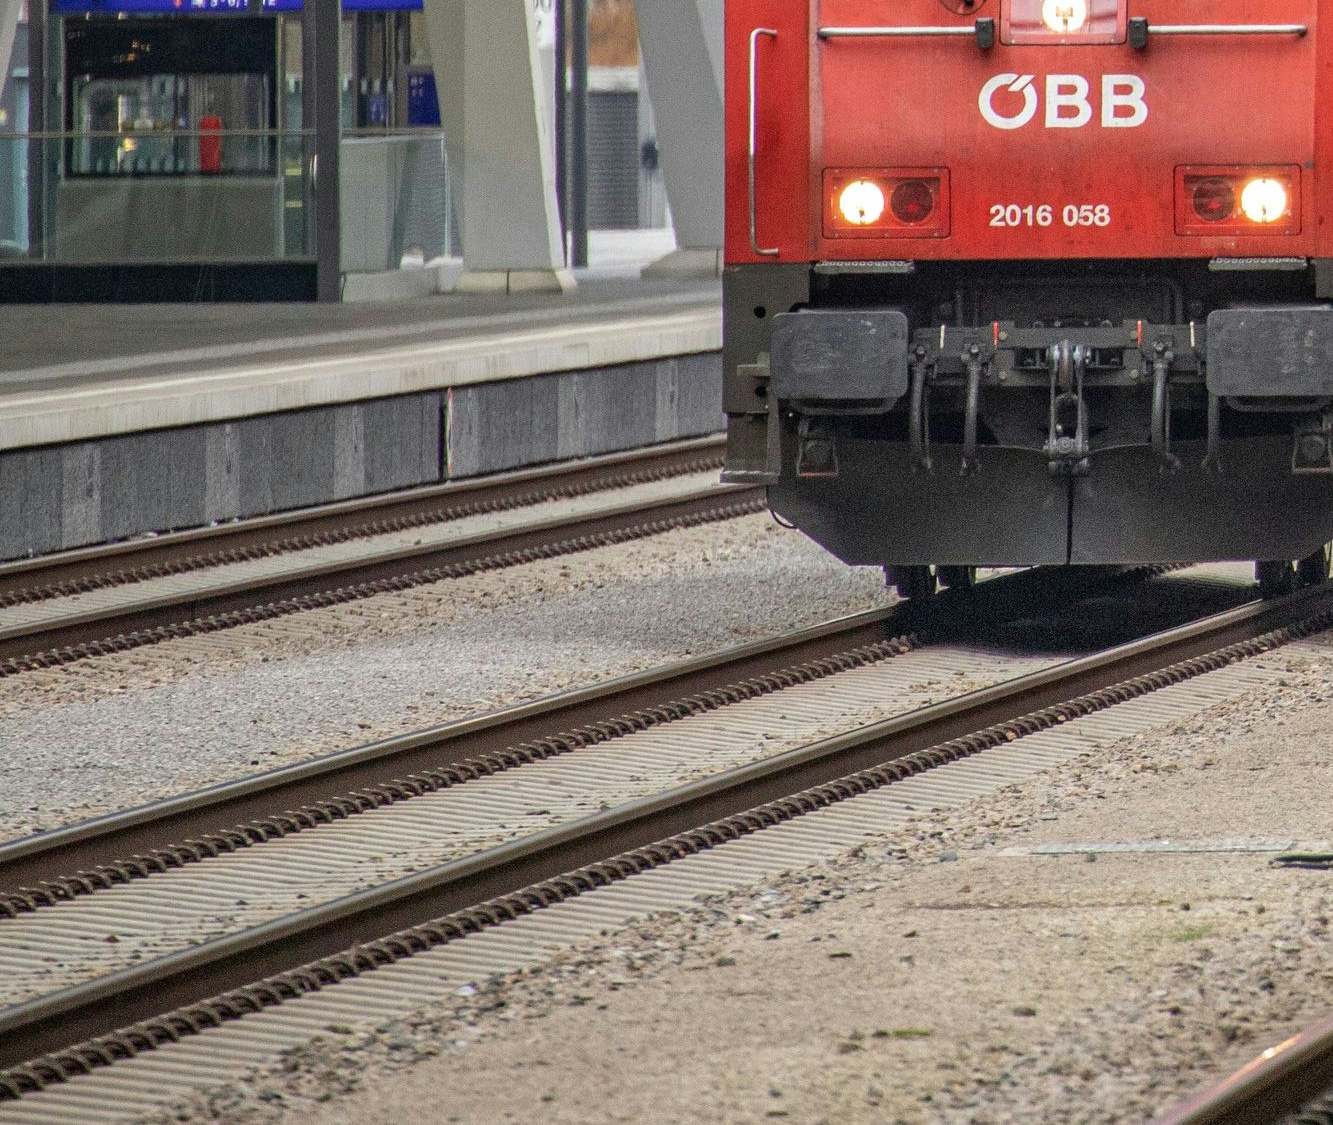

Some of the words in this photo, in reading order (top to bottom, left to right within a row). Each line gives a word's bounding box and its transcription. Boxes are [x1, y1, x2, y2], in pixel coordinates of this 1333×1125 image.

[978, 73, 1148, 129] ÖBB
[989, 205, 1052, 227] 2016
[1062, 205, 1110, 227] 058
